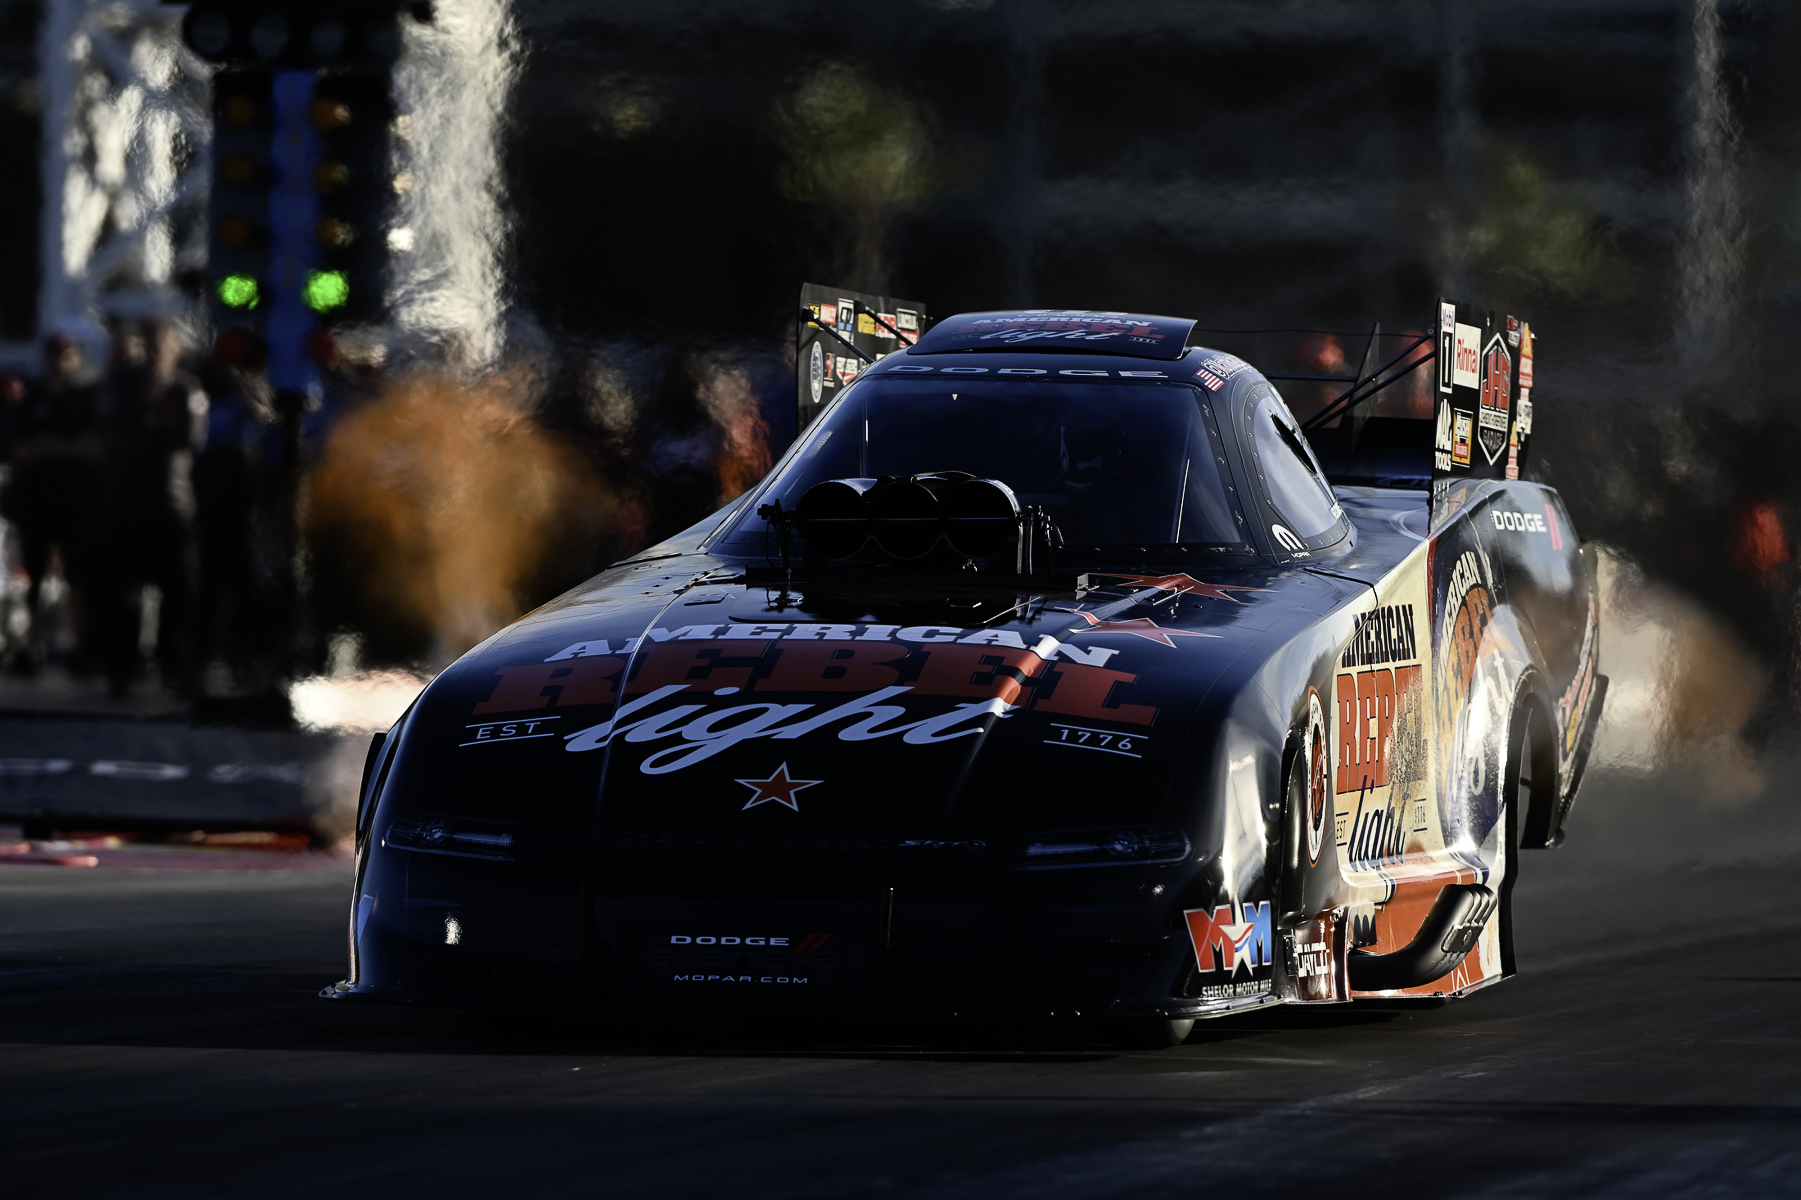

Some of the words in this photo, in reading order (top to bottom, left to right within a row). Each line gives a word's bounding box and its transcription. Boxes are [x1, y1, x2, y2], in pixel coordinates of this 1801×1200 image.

[951, 321, 1165, 340] REBEL
[970, 317, 1152, 327] AMERICAN
[1456, 338, 1479, 374] Rinnai
[886, 366, 1169, 379] DODGE
[1492, 510, 1547, 533] DODGE
[543, 624, 1120, 668] AMERICAN
[1341, 604, 1417, 669] AMERICAN
[471, 639, 1158, 727] REBEL
[476, 722, 542, 740] EST
[563, 684, 1022, 776] light
[1059, 728, 1133, 751] 1776
[670, 935, 790, 947] DODGE
[673, 974, 809, 984] MOPAR.COM
[1202, 984, 1235, 999] SHELOR
[1236, 981, 1259, 997] MOTOR
